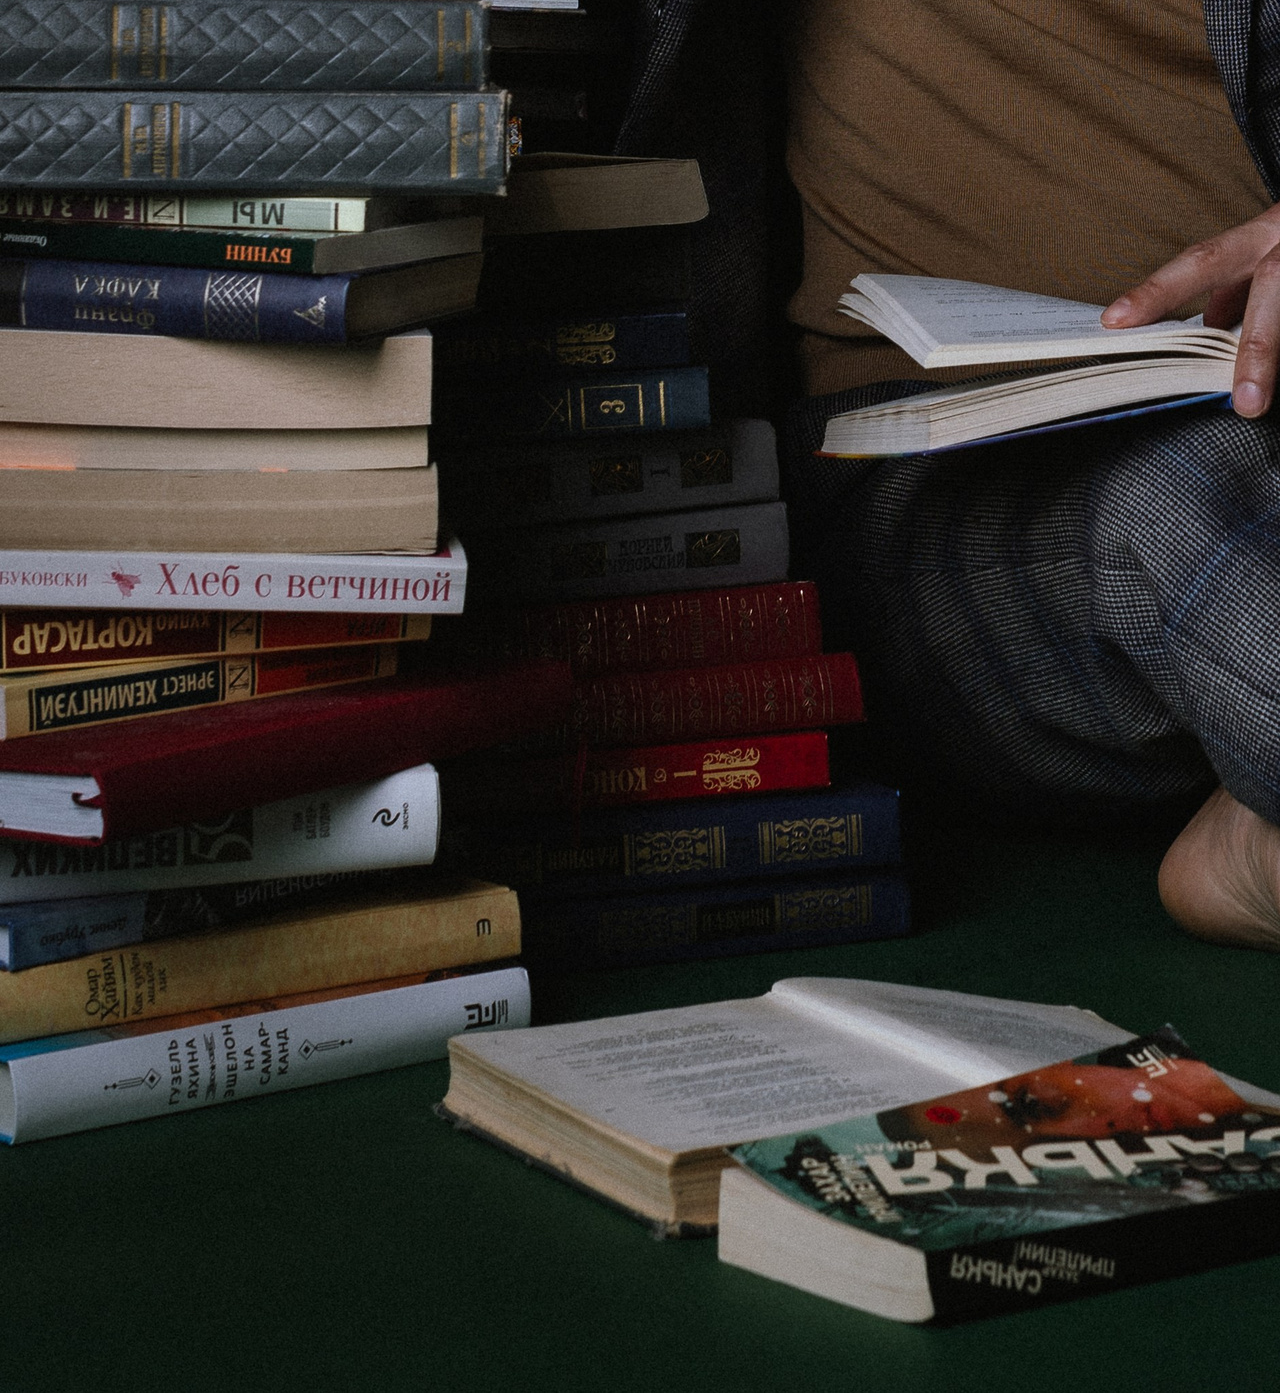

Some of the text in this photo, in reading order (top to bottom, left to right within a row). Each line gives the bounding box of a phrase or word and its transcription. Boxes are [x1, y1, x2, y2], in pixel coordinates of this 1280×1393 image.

[232, 201, 285, 225] МЫ
[225, 243, 292, 265] БУНИН
[74, 273, 160, 300] КАФКА
[74, 306, 155, 330] Франц
[619, 536, 673, 554] КОРНЕЙ
[0, 571, 88, 589] БУКОВСКИ
[156, 562, 453, 602] Хлеб с ветчиной
[13, 615, 153, 656] КОРТАСАР
[40, 673, 216, 725] ЭРНЕСТ ХЕМИНГУЭЙ
[401, 802, 409, 831] ЭКСМО
[86, 915, 128, 939] Денис
[84, 968, 101, 1016] Омар
[99, 955, 120, 1021] Хайям
[168, 1039, 182, 1105] ГУЗЕЛЬ
[185, 1037, 200, 1099] ЯХИНА
[221, 1023, 237, 1098] ЭШЕЛОН
[244, 1045, 255, 1071] НА
[258, 1021, 272, 1085] САМАР-
[275, 1028, 290, 1076] КАНД
[948, 1251, 1043, 1297] САНЬКЯ
[1016, 1241, 1115, 1279] ПРИЛЕПИН
